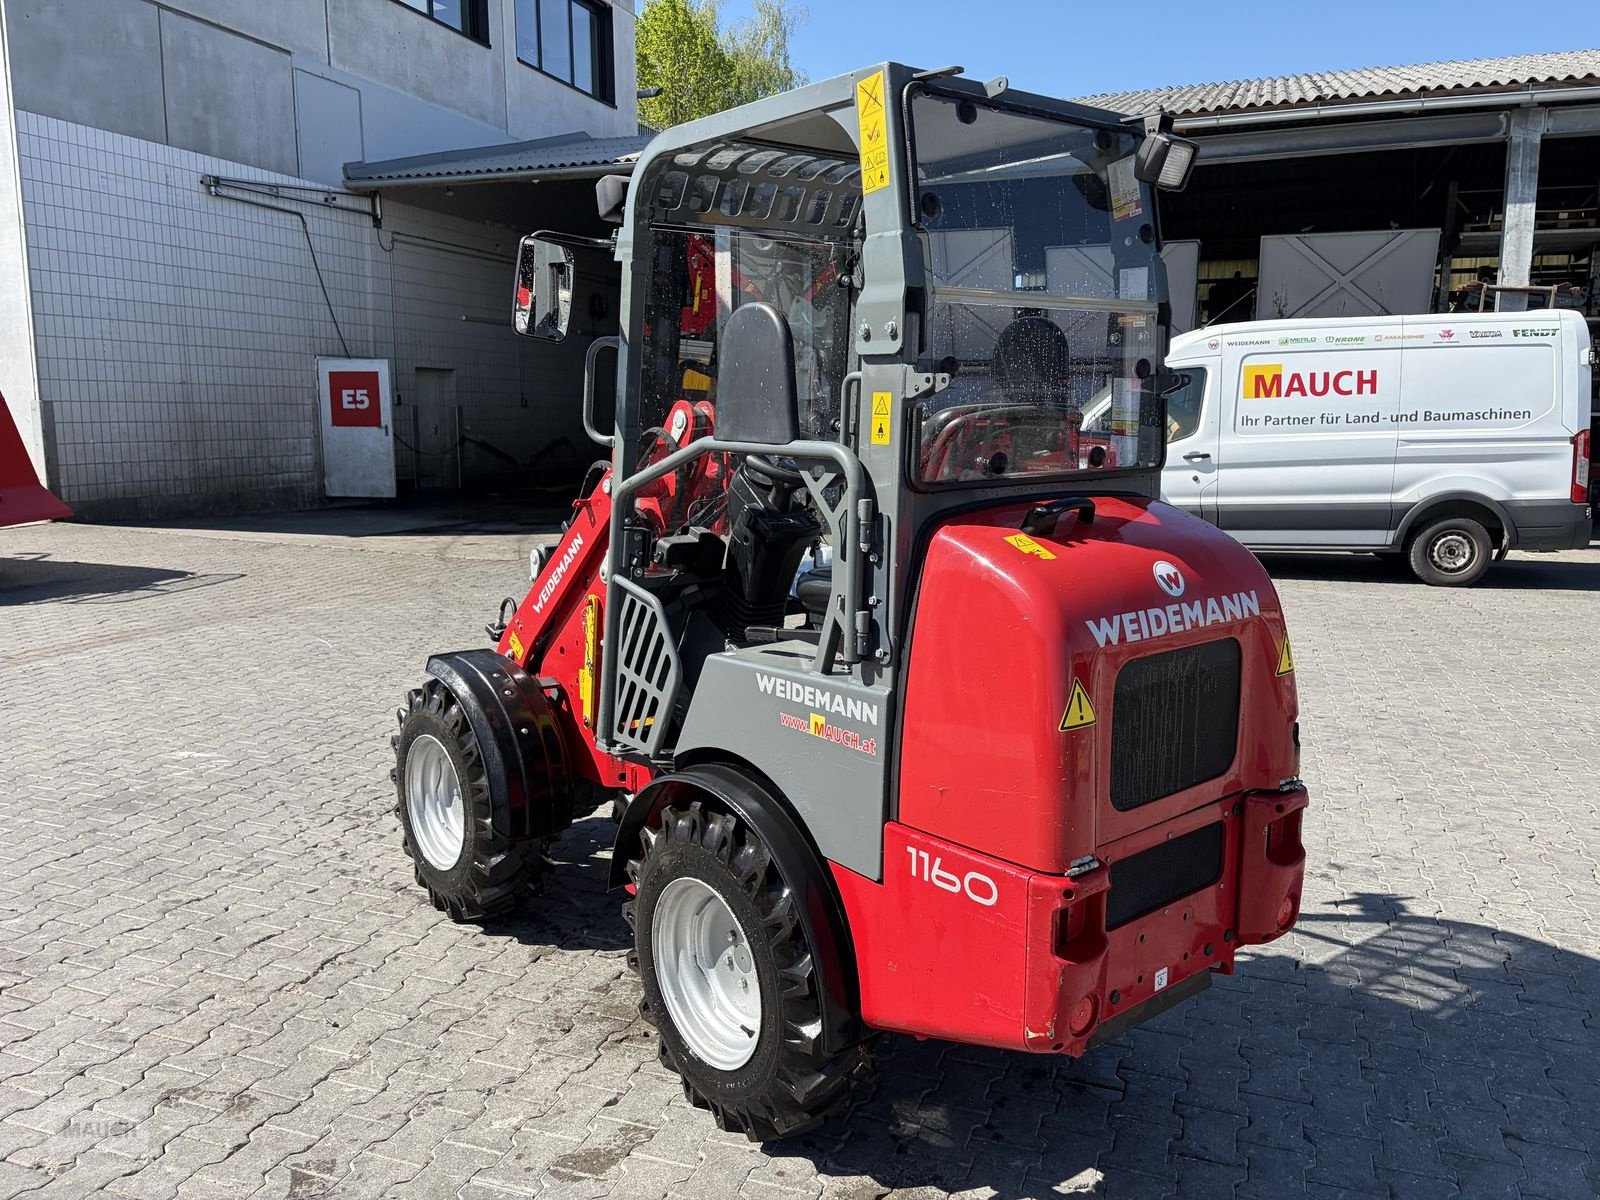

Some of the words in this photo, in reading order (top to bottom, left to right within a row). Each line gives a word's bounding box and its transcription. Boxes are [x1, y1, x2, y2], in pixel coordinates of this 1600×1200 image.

[1512, 328, 1560, 337] FENDT
[342, 389, 370, 410] E5
[1254, 369, 1377, 398] MAUCH
[1241, 415, 1260, 427] Ihr
[1264, 415, 1316, 426] Partner
[1320, 413, 1341, 425] für
[1390, 410, 1418, 423] und
[1423, 408, 1532, 422] Baumaschinen
[532, 533, 584, 614] WEIDEMANN
[1085, 590, 1260, 648] WEIDEMANN
[755, 672, 878, 726] WEIDEMANN
[780, 712, 877, 756] www.MAUCH.at
[906, 845, 998, 906] 1160
